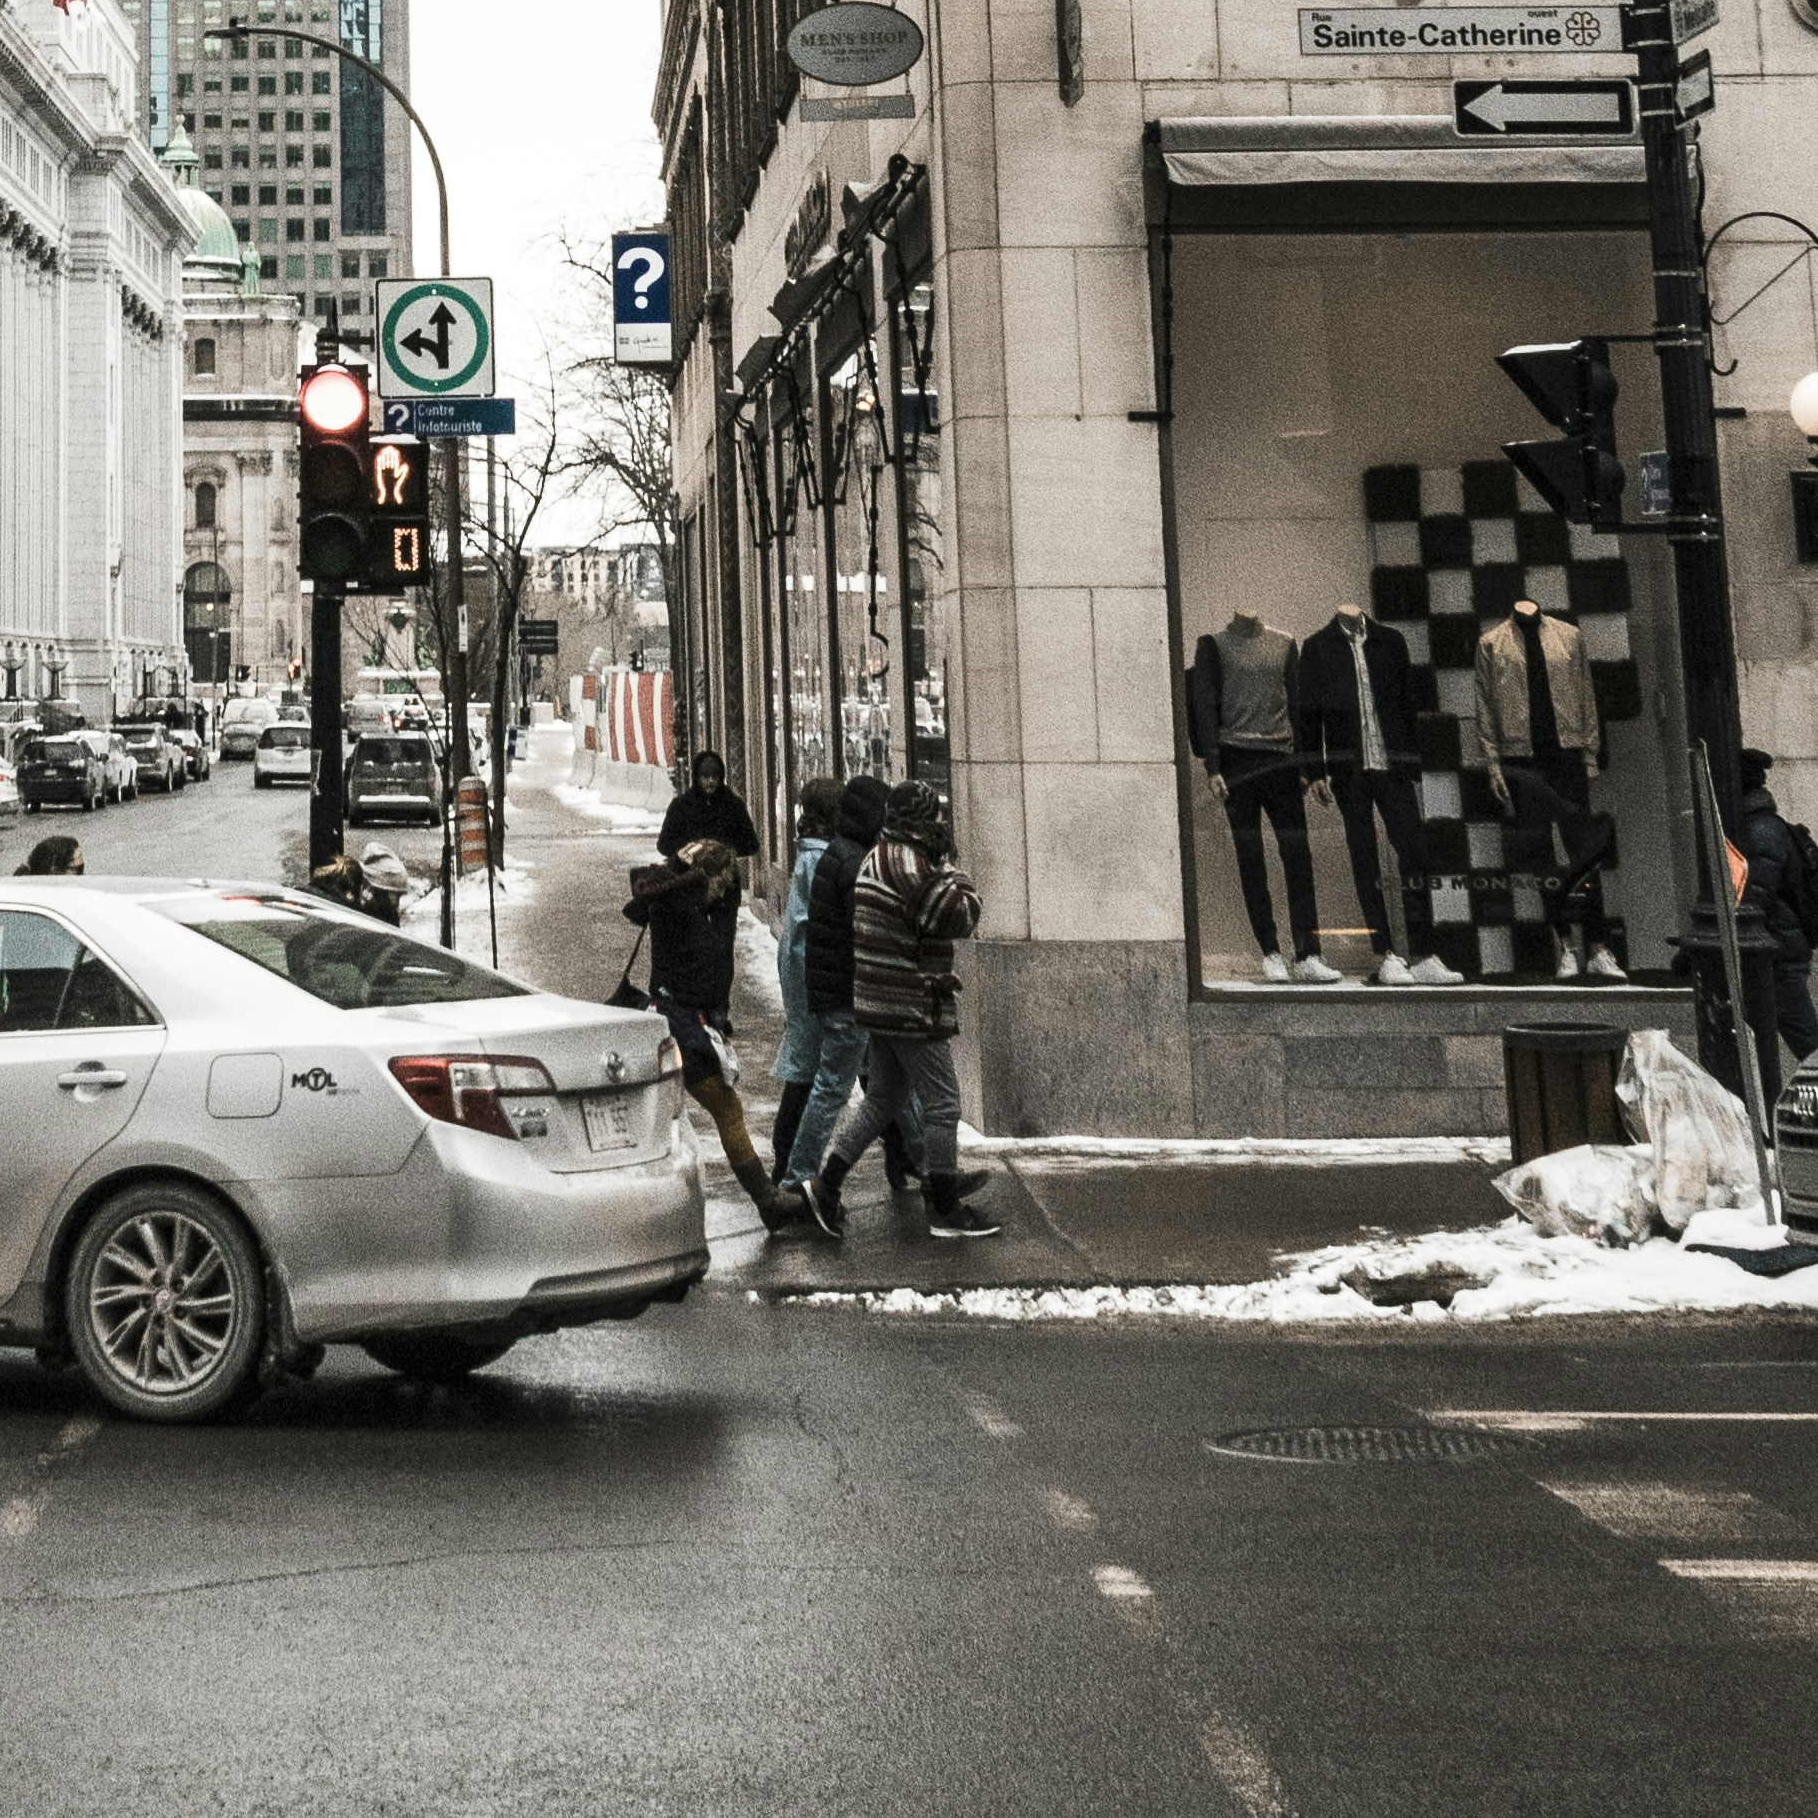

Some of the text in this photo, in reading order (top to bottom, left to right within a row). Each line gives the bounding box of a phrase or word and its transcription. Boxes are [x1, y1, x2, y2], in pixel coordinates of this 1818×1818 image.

[1528, 9, 1559, 18] ouest
[800, 31, 908, 47] MEN'S SHOP
[1313, 23, 1562, 48] Sainte-Catherine
[417, 404, 455, 417] Centre
[417, 421, 483, 433] Infotouriste
[291, 1066, 338, 1093] MTL
